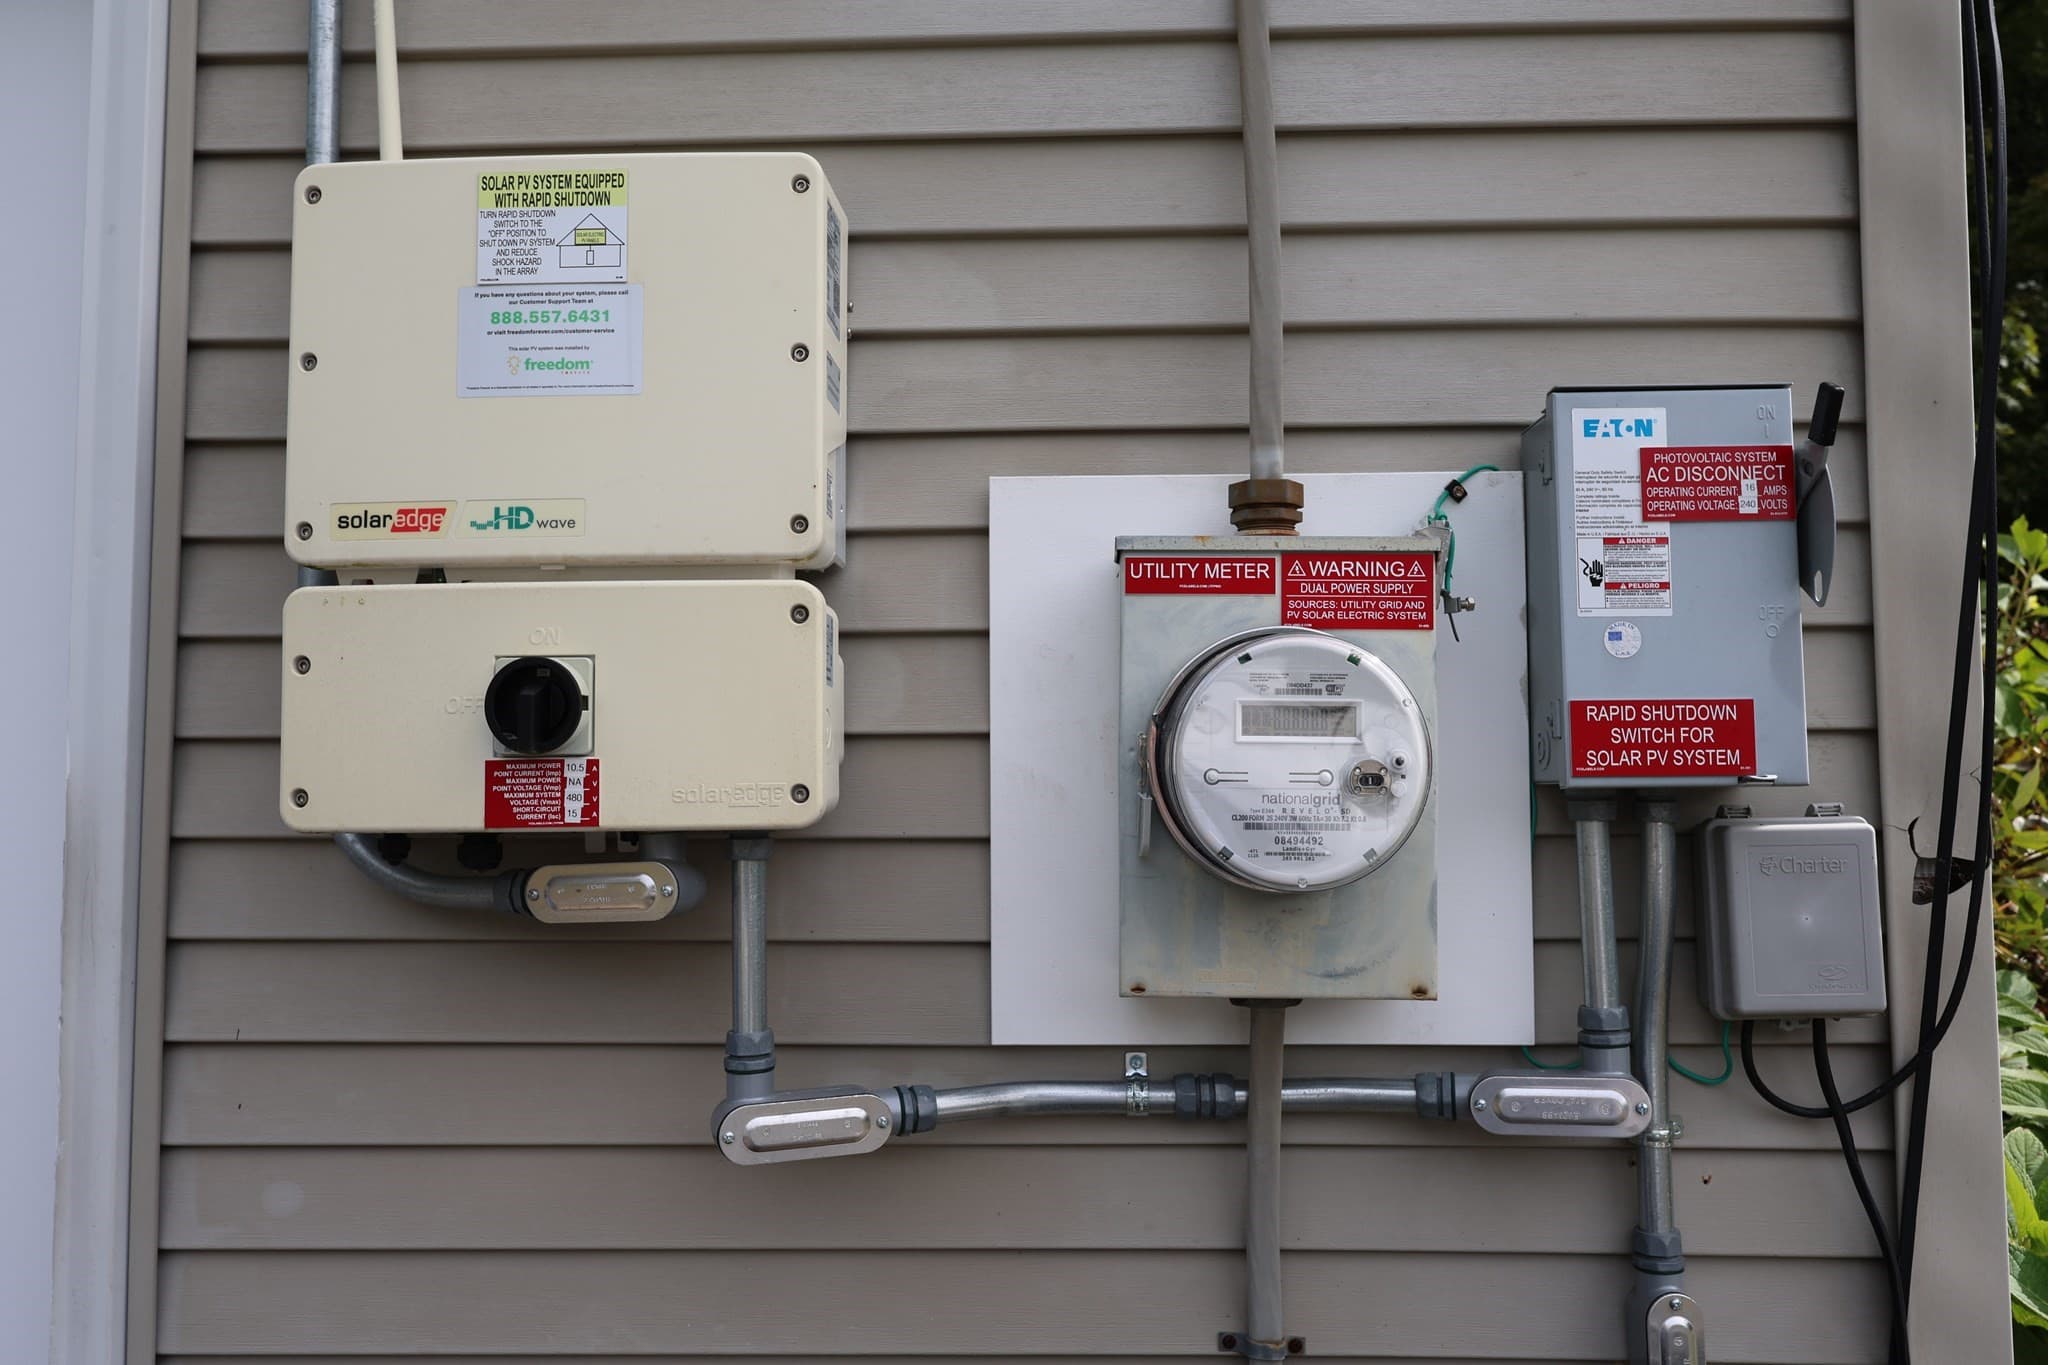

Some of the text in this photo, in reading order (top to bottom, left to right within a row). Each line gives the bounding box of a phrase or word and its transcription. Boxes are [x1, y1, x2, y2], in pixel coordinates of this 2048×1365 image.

[482, 173, 624, 191] SOLAR PV SYSTEM EQUIPPED
[495, 191, 610, 208] WITH RAPID SHUTDOWN
[490, 310, 609, 325] 888.557.6431
[524, 357, 590, 371] freedom
[1757, 405, 1776, 420] ON
[1654, 452, 1776, 463] PHOTOVOLTAIC SYSTEM
[1646, 467, 1669, 482] AC
[1675, 465, 1785, 481] DISCONNECT
[1647, 483, 1787, 498] OPERATING CURRENT: 16 AMPS
[1647, 501, 1695, 512] OPERATING
[1698, 500, 1736, 510] VOLTAGE:
[1740, 500, 1756, 509] 240
[1761, 499, 1787, 510] VOLTS
[338, 508, 447, 533] solaredge
[494, 506, 576, 530] HD wave
[1130, 562, 1270, 580] UTILITY METER
[1309, 561, 1404, 577] WARNING
[1300, 583, 1414, 594] DUAL POWER SUPPLY
[1288, 601, 1425, 610] SOURCES: UTILITY GRID AND
[1759, 605, 1784, 621] OFF
[1287, 611, 1426, 620] PV SOLAR ELECTRIC SYSTEM
[528, 627, 560, 645] ON
[1586, 705, 1737, 721] RAPID SHUTDOWN
[1611, 727, 1715, 744] SWITCH FOR
[1586, 749, 1740, 766] SOLAR PV SYSTEM
[567, 764, 584, 772] 10.5
[671, 784, 785, 806] solaredge
[1262, 793, 1340, 808] nationalgrid
[1274, 836, 1324, 845] 08494492
[1780, 856, 1848, 874] Charter
